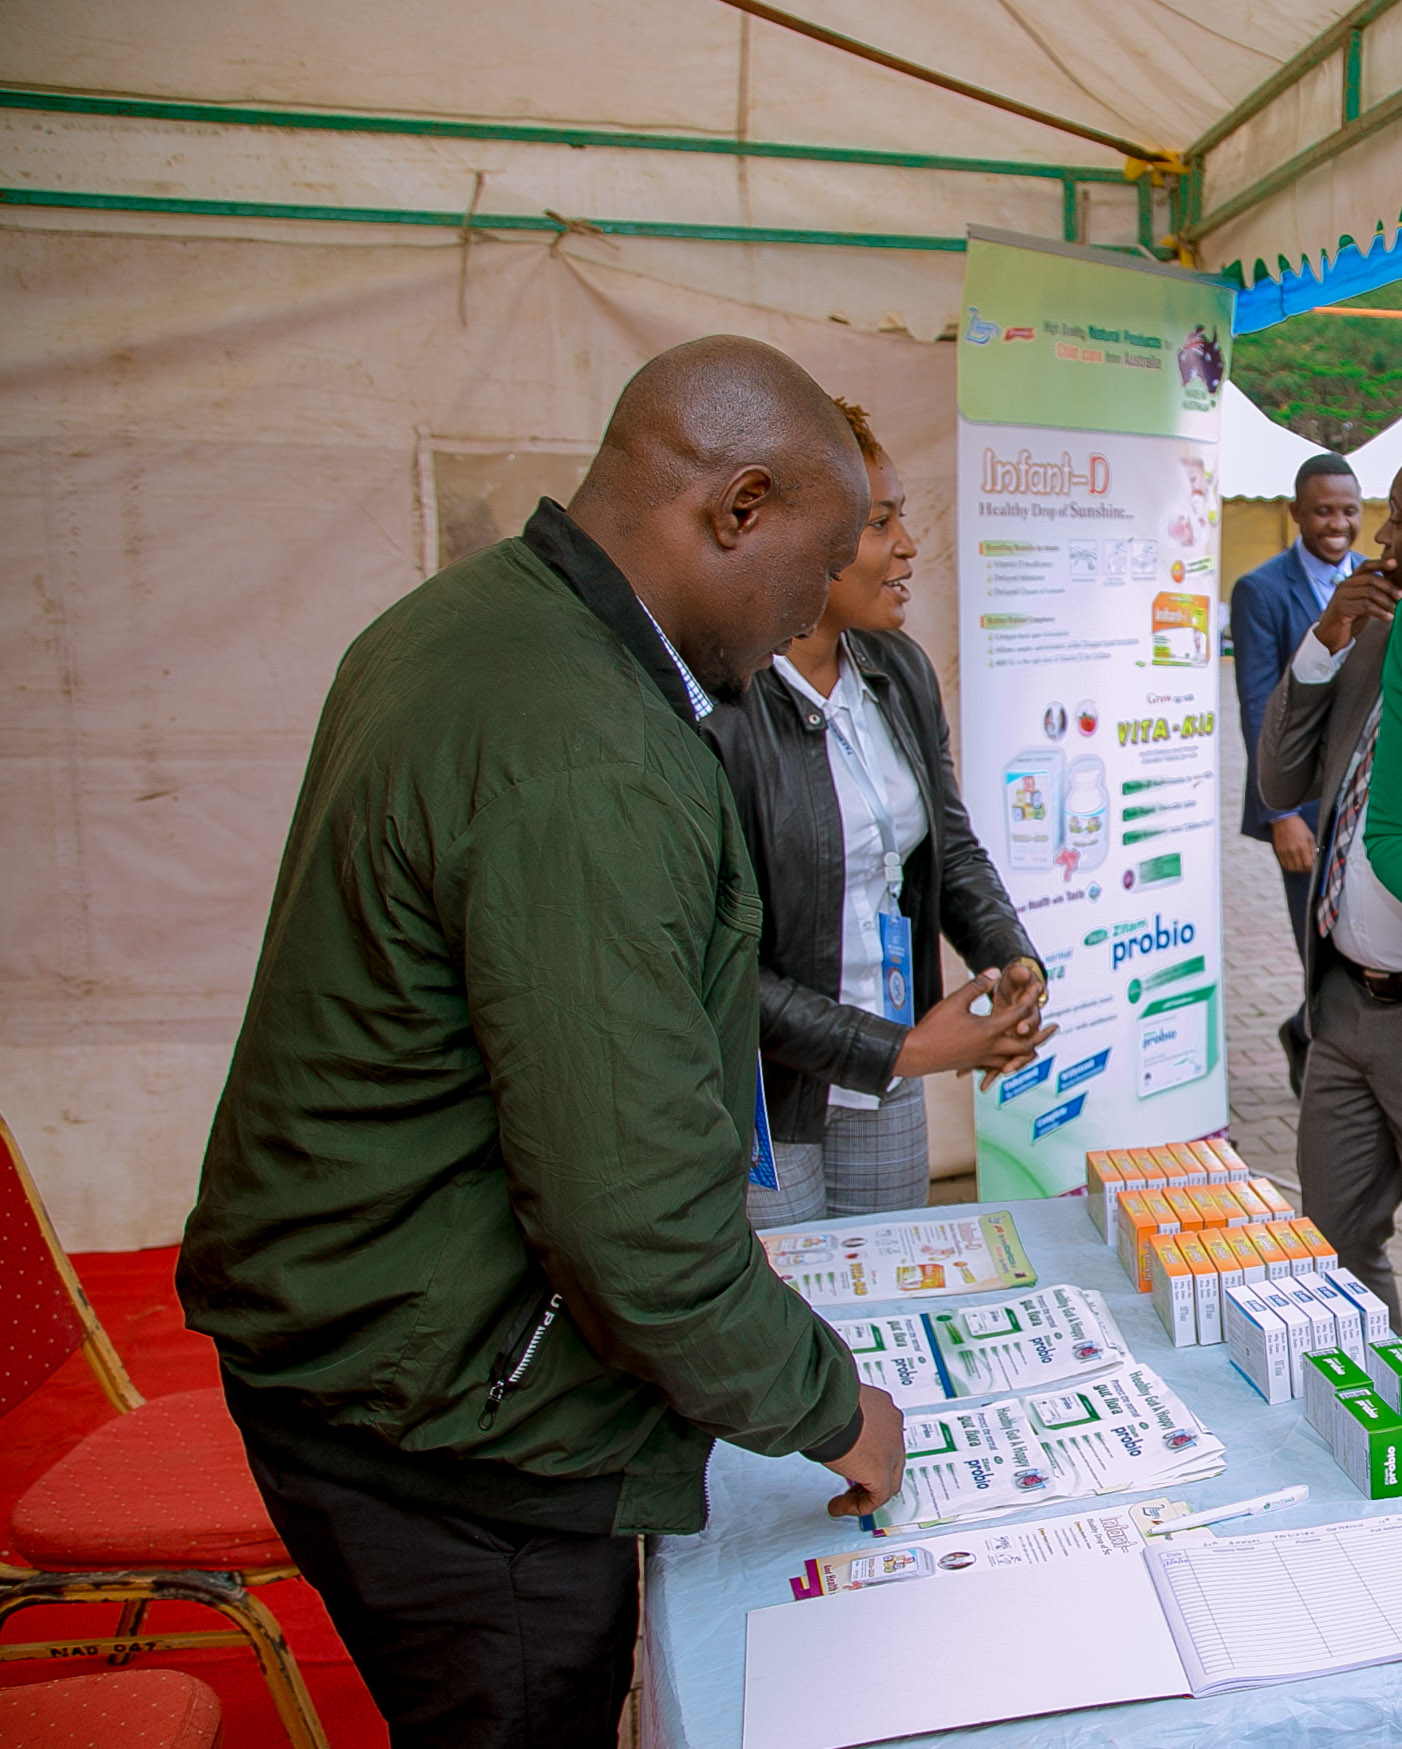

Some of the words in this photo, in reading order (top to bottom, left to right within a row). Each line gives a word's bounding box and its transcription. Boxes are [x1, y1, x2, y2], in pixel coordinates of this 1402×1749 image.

[981, 447, 1110, 498] Infant-D
[978, 501, 1029, 520] Healthy
[1031, 502, 1057, 521] Drop
[1112, 913, 1194, 971] probio
[1028, 1337, 1056, 1364] probio
[891, 1357, 918, 1386] probio
[1092, 1384, 1113, 1400] gut
[1104, 1397, 1124, 1415] flora
[1129, 1370, 1154, 1397] Healthy
[1156, 1411, 1177, 1430] Happy
[956, 1415, 976, 1429] gut
[996, 1406, 1017, 1431] Healthy
[1012, 1444, 1031, 1468] Happy
[965, 1429, 982, 1447] flora
[1110, 1425, 1144, 1457] probio
[963, 1459, 995, 1490] probio
[1384, 1445, 1399, 1485] probio
[1099, 1514, 1138, 1554] Infant-
